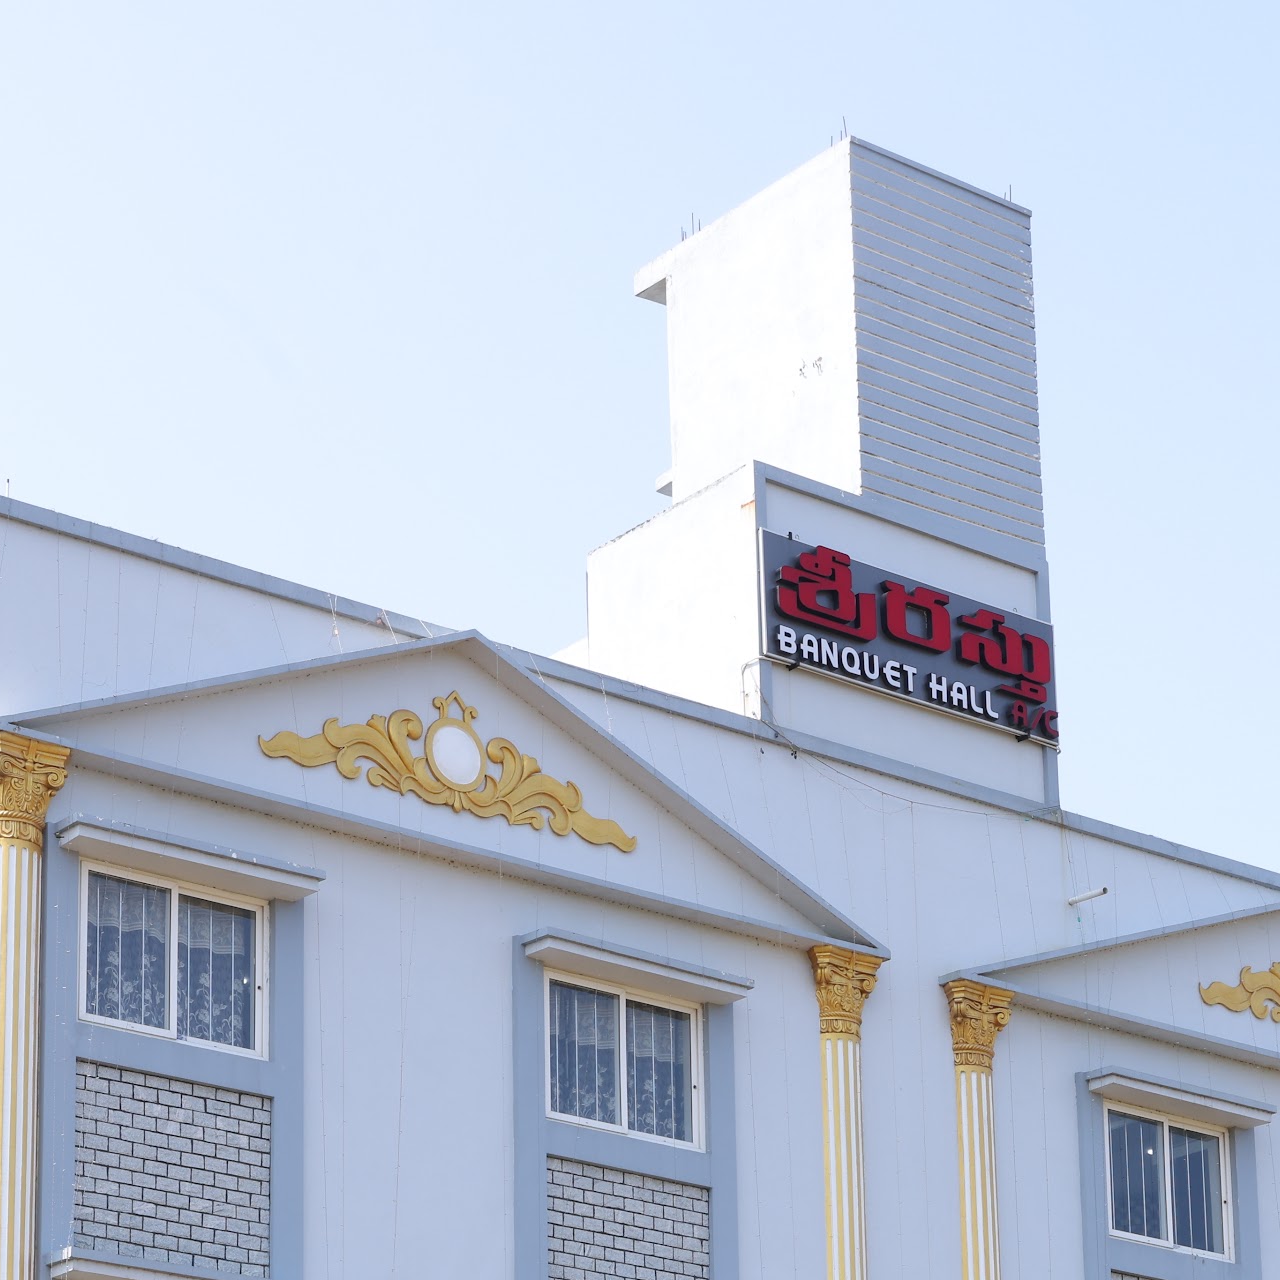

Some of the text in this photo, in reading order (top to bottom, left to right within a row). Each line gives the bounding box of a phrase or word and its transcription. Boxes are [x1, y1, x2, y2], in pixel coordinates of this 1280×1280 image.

[777, 625, 1059, 738] BANQUET HALL A/C
